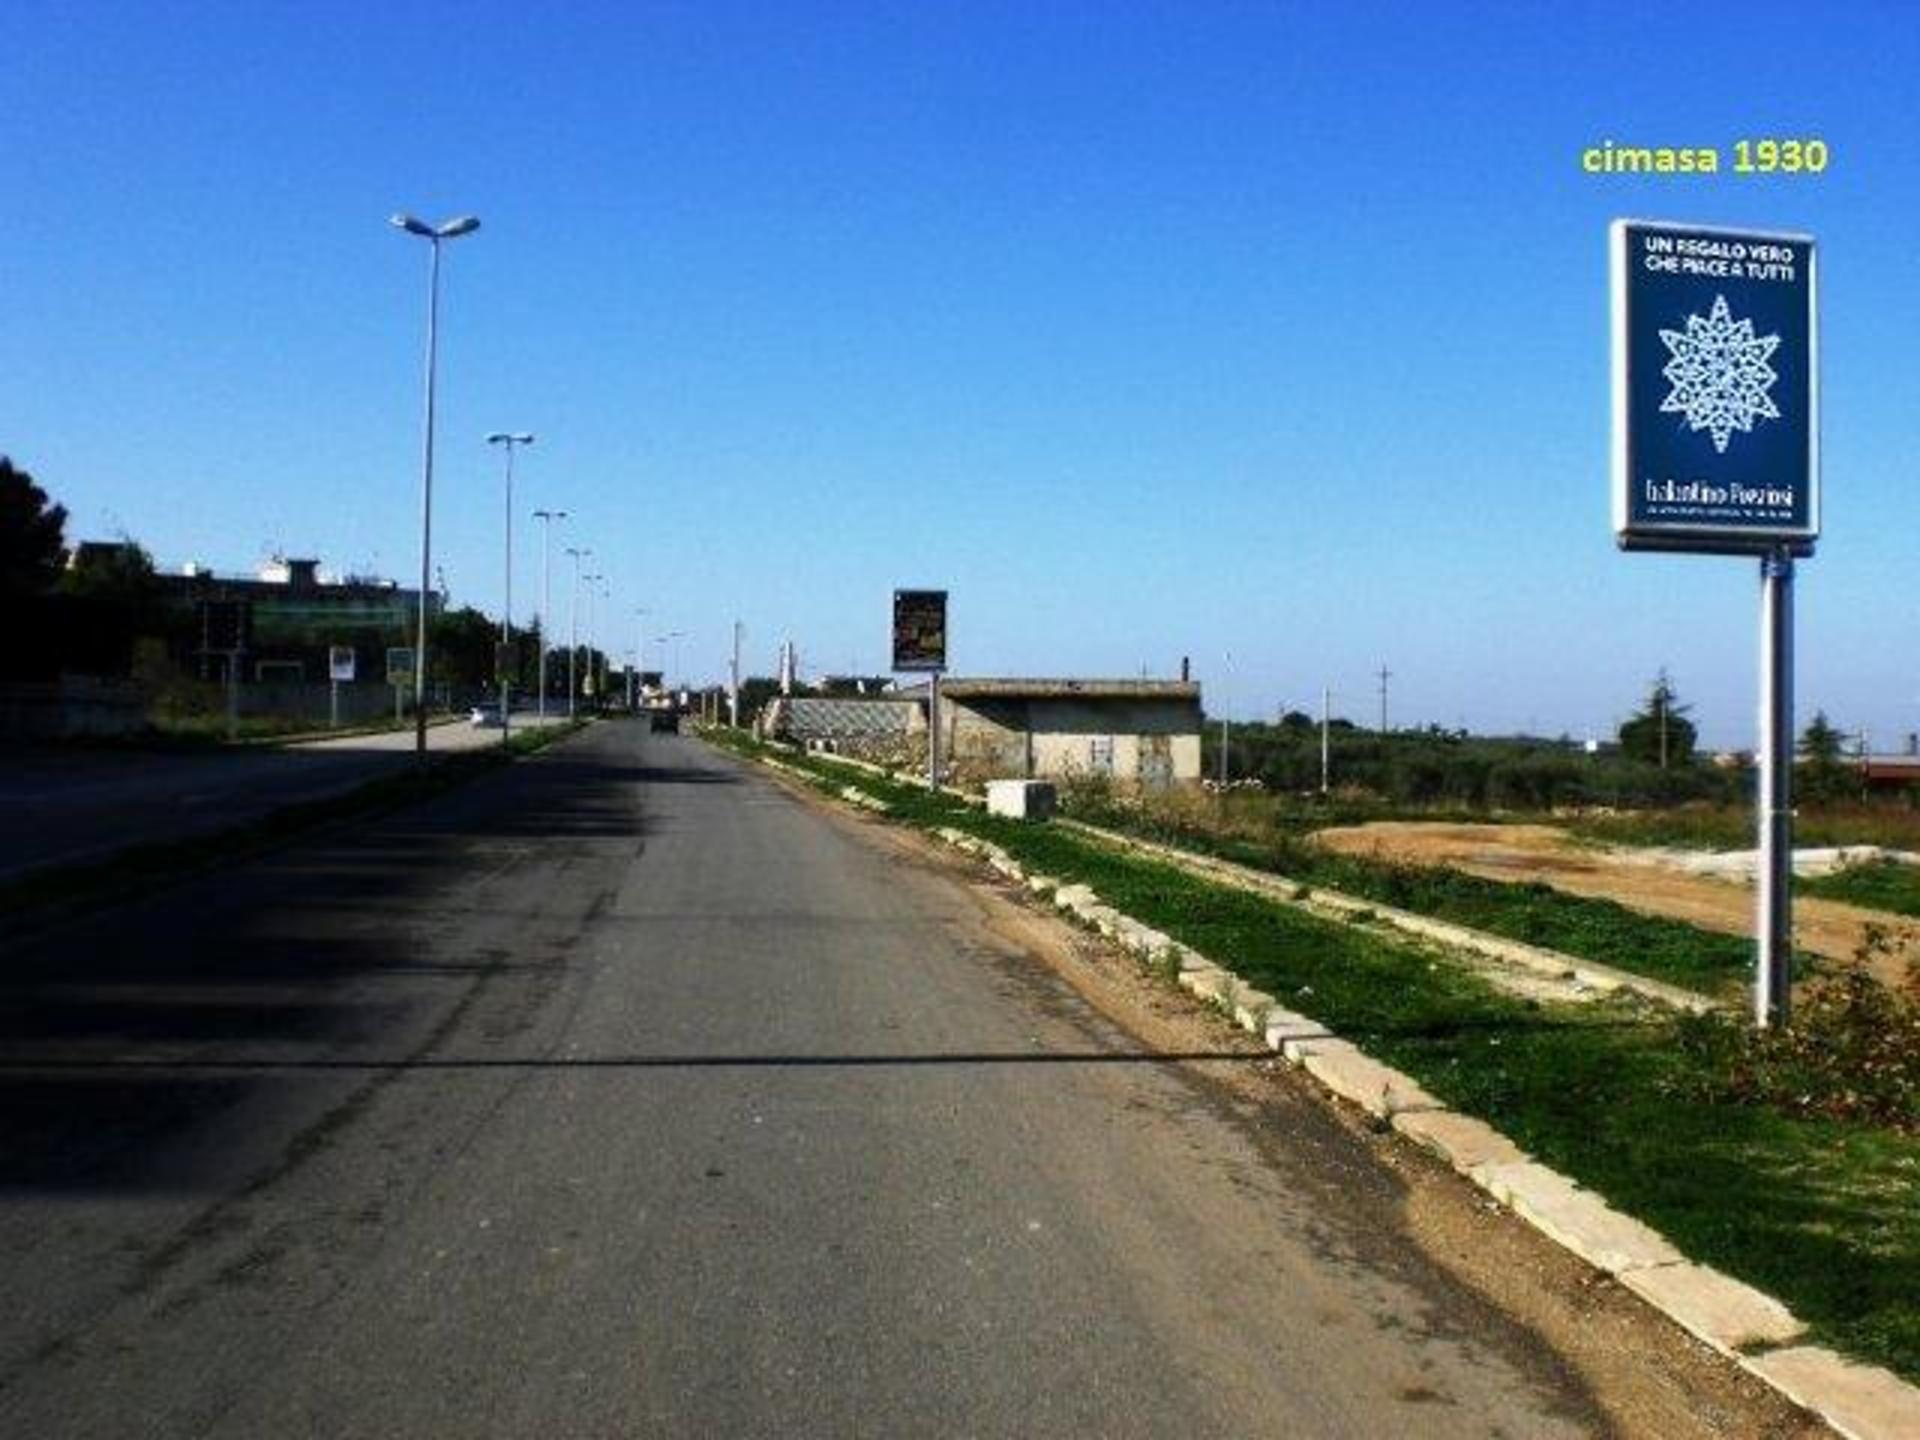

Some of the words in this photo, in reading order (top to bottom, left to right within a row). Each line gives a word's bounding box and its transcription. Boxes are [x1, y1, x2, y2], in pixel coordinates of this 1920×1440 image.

[1645, 237, 1673, 253] UN
[1677, 239, 1747, 260] REGALO
[1749, 245, 1794, 264] VERO
[1645, 254, 1678, 274] CHE
[1682, 257, 1729, 277] PIACE
[1731, 262, 1743, 276] A
[1746, 264, 1795, 282] TUTTI
